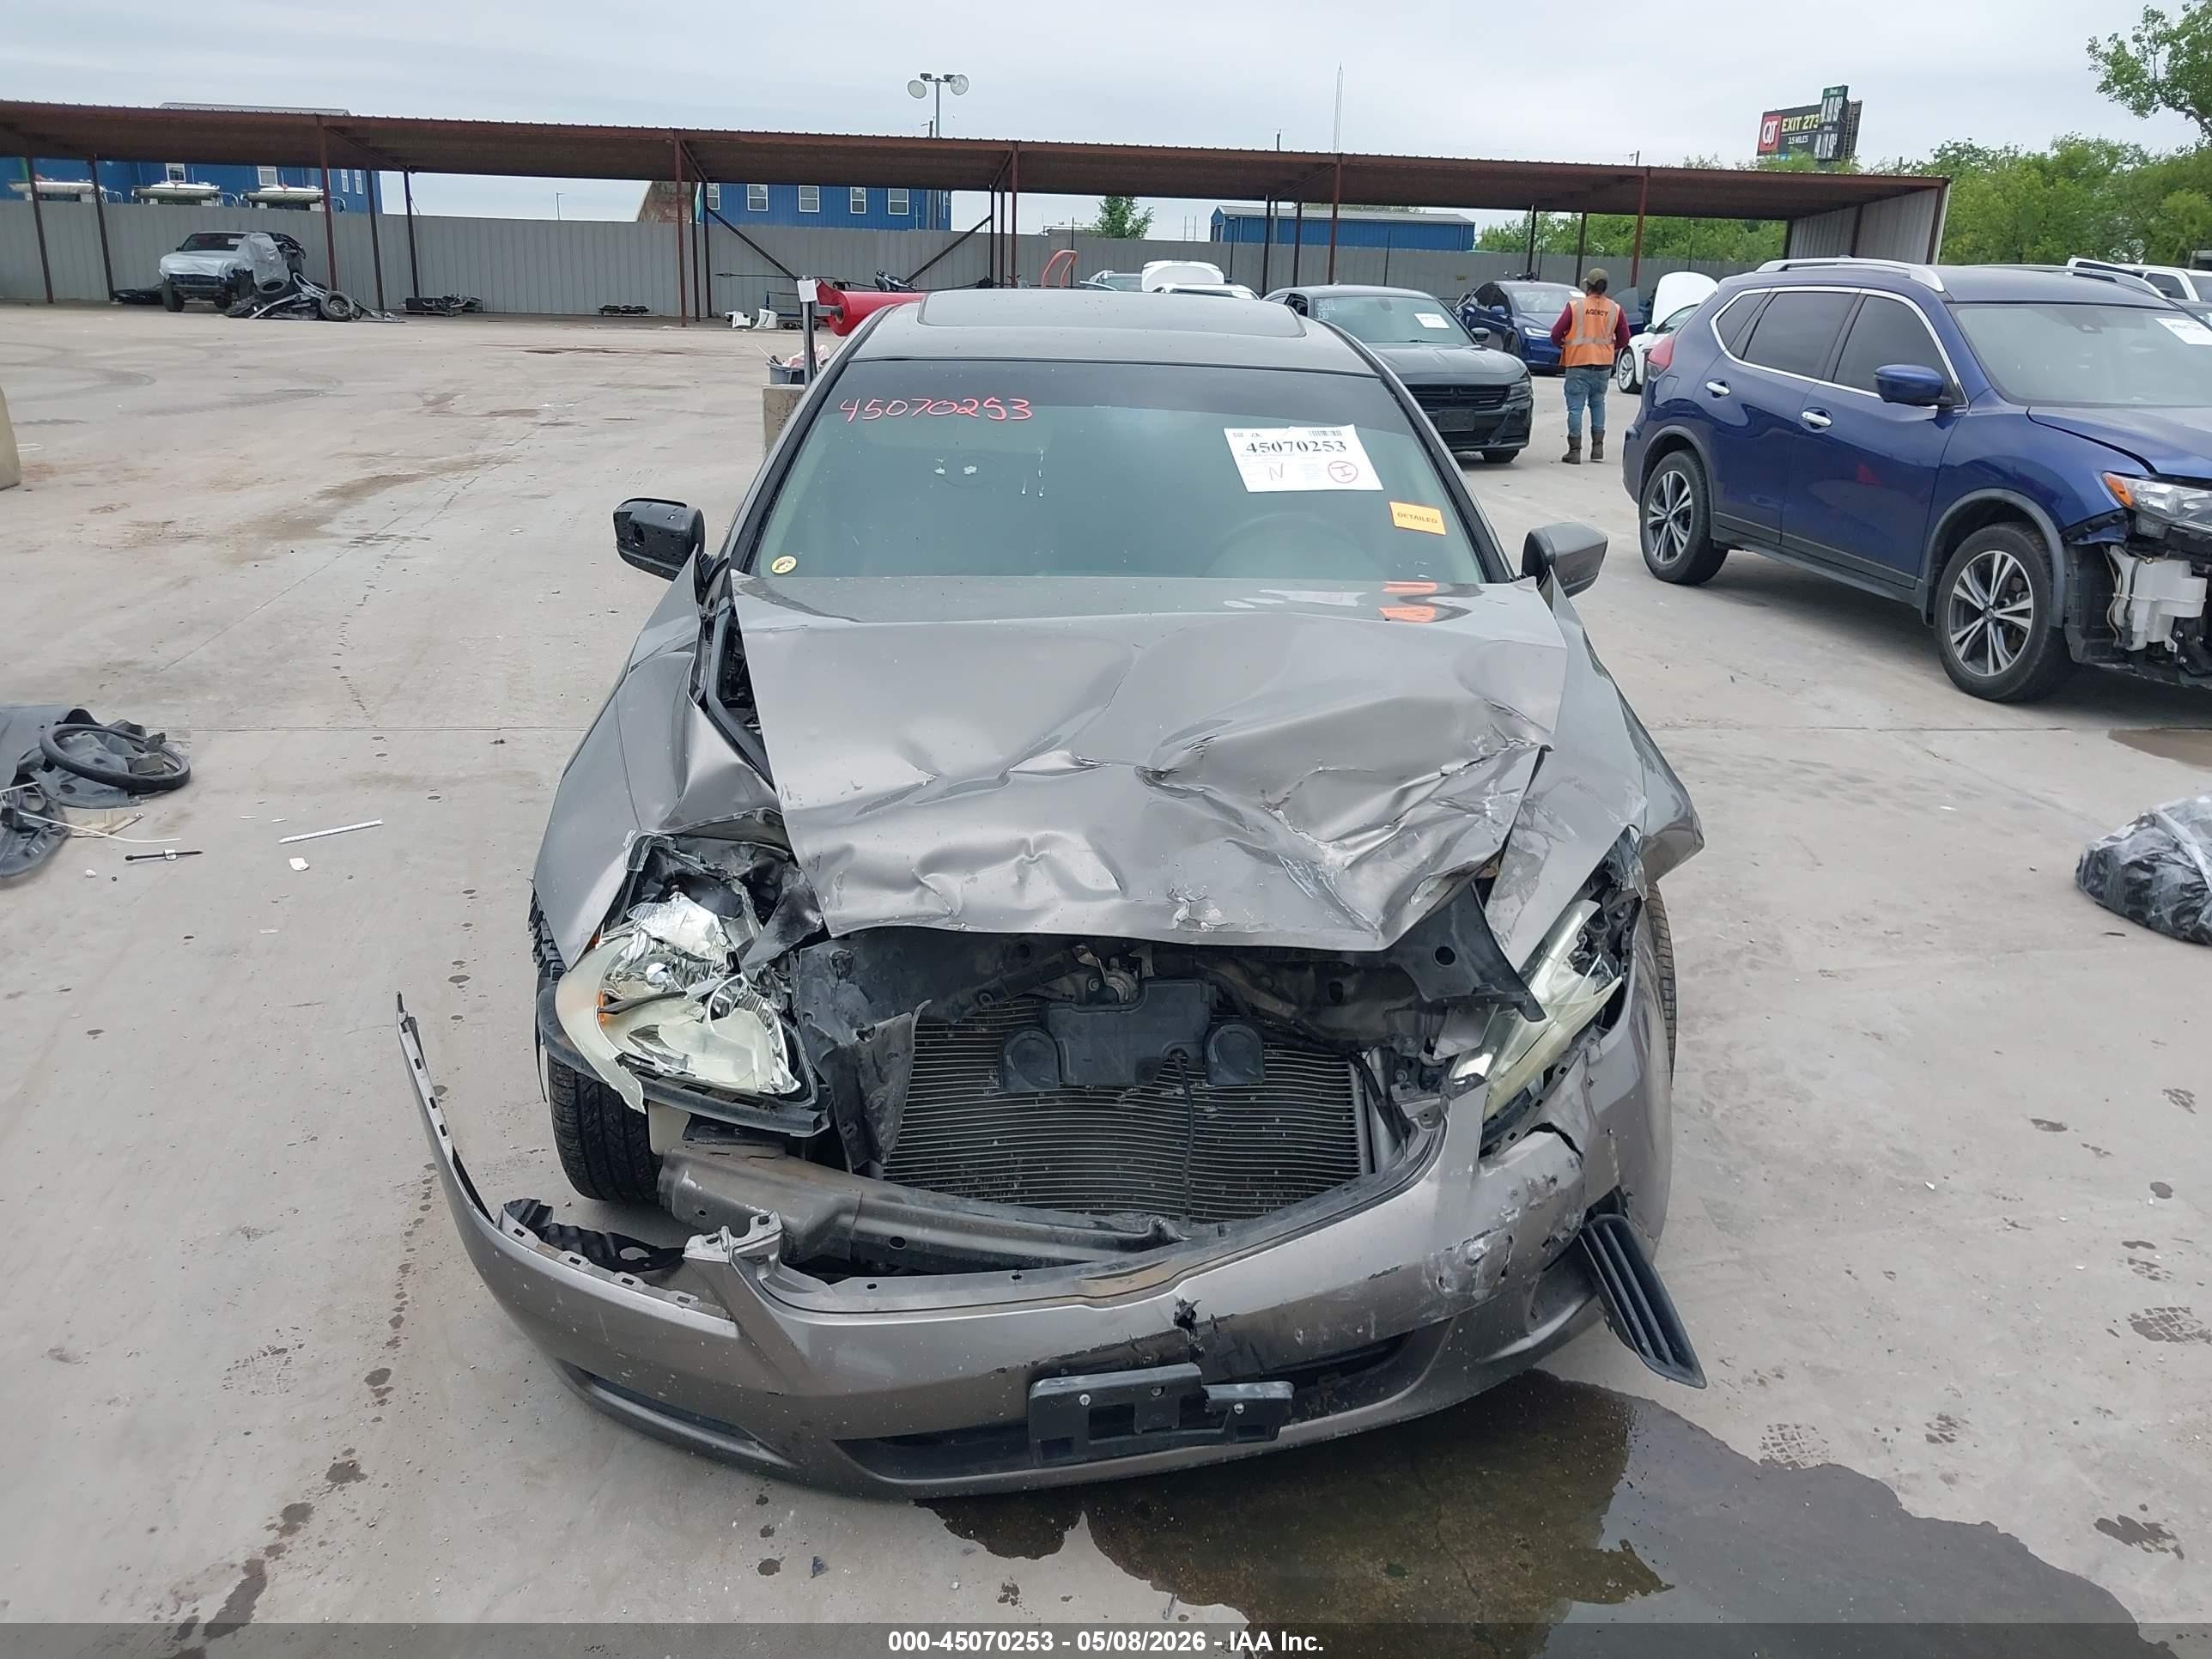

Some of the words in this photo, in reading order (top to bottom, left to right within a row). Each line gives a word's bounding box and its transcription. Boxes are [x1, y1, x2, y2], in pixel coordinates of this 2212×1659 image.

[1782, 117, 1802, 132] EXIT
[1802, 114, 1820, 130] 273
[1763, 121, 1778, 144] QT
[1796, 135, 1808, 143] MILES
[839, 397, 1033, 422] 45070253
[1245, 440, 1347, 454] 45070253
[1269, 463, 1284, 481] N
[1397, 511, 1438, 524] DETAILED
